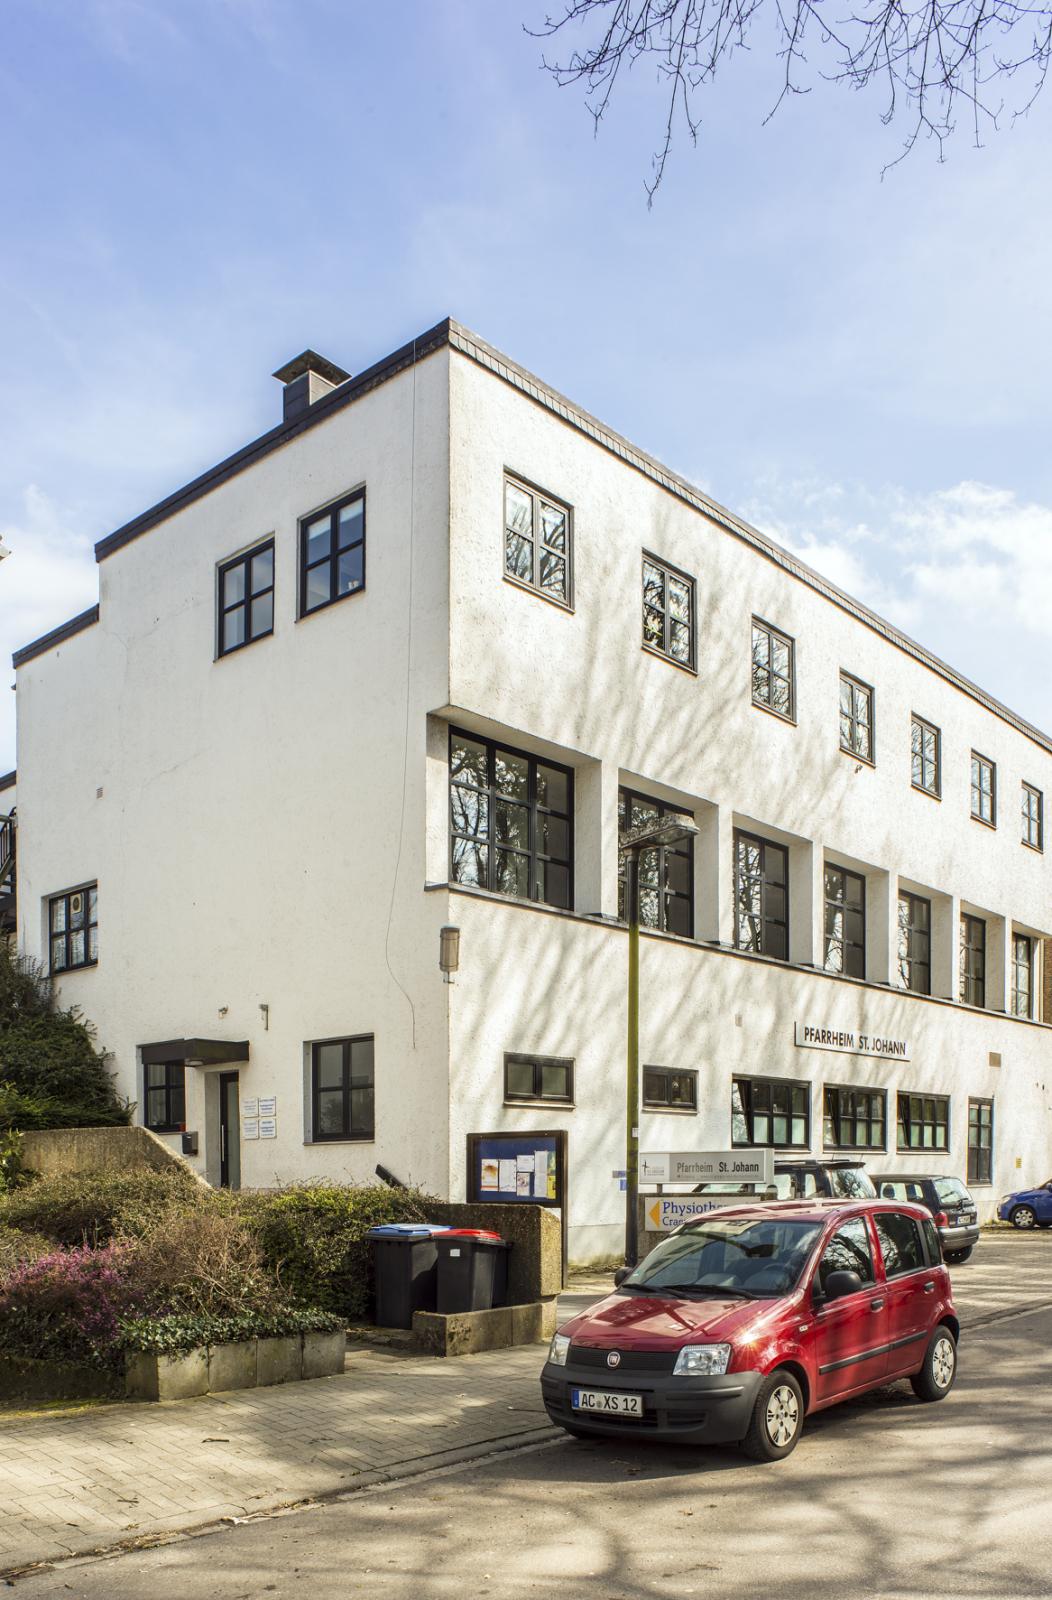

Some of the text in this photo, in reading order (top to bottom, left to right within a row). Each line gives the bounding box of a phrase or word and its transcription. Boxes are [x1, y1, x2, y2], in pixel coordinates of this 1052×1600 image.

[804, 1027, 906, 1055] PFARRHEIM ST. JOHANN
[677, 1162, 713, 1173] Pfarrheim
[718, 1161, 730, 1173] St.
[731, 1160, 760, 1172] Johann
[581, 1393, 638, 1412] AC XS 12
